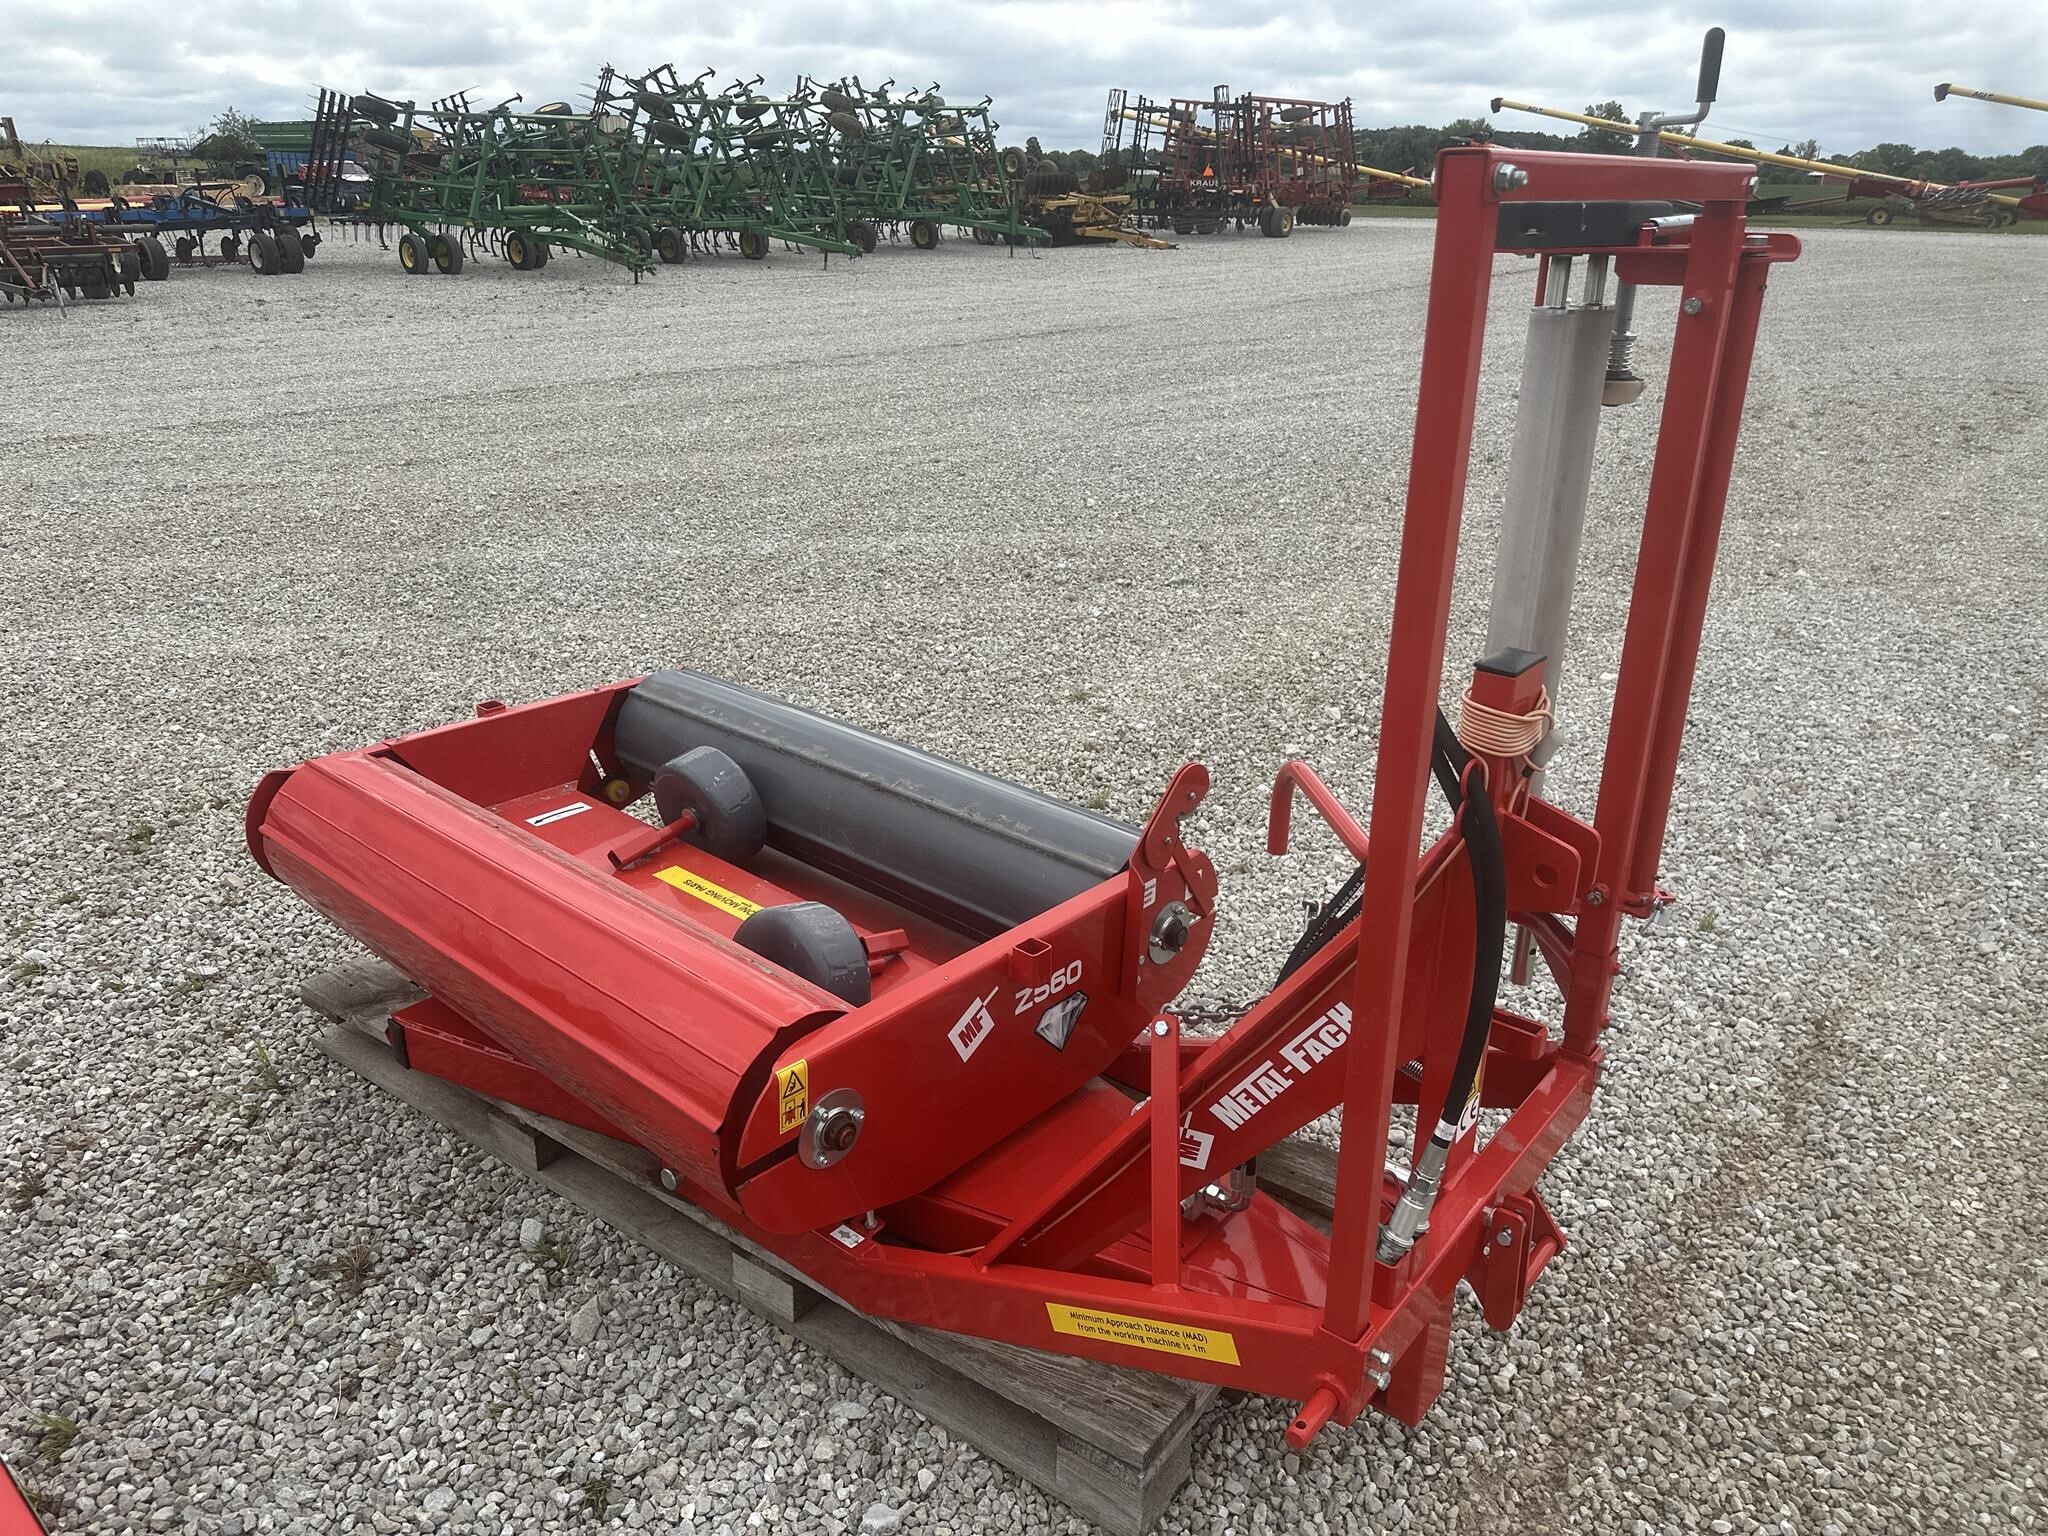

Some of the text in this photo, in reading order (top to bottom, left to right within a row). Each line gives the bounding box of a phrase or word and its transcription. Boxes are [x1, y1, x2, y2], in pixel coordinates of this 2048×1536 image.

[683, 879, 708, 892] PARTS
[705, 889, 741, 909] MOVING
[1069, 1311, 1208, 1345] Minimum Approach Distance (MAD)
[1077, 1322, 1207, 1354] from the working machine is 1m
